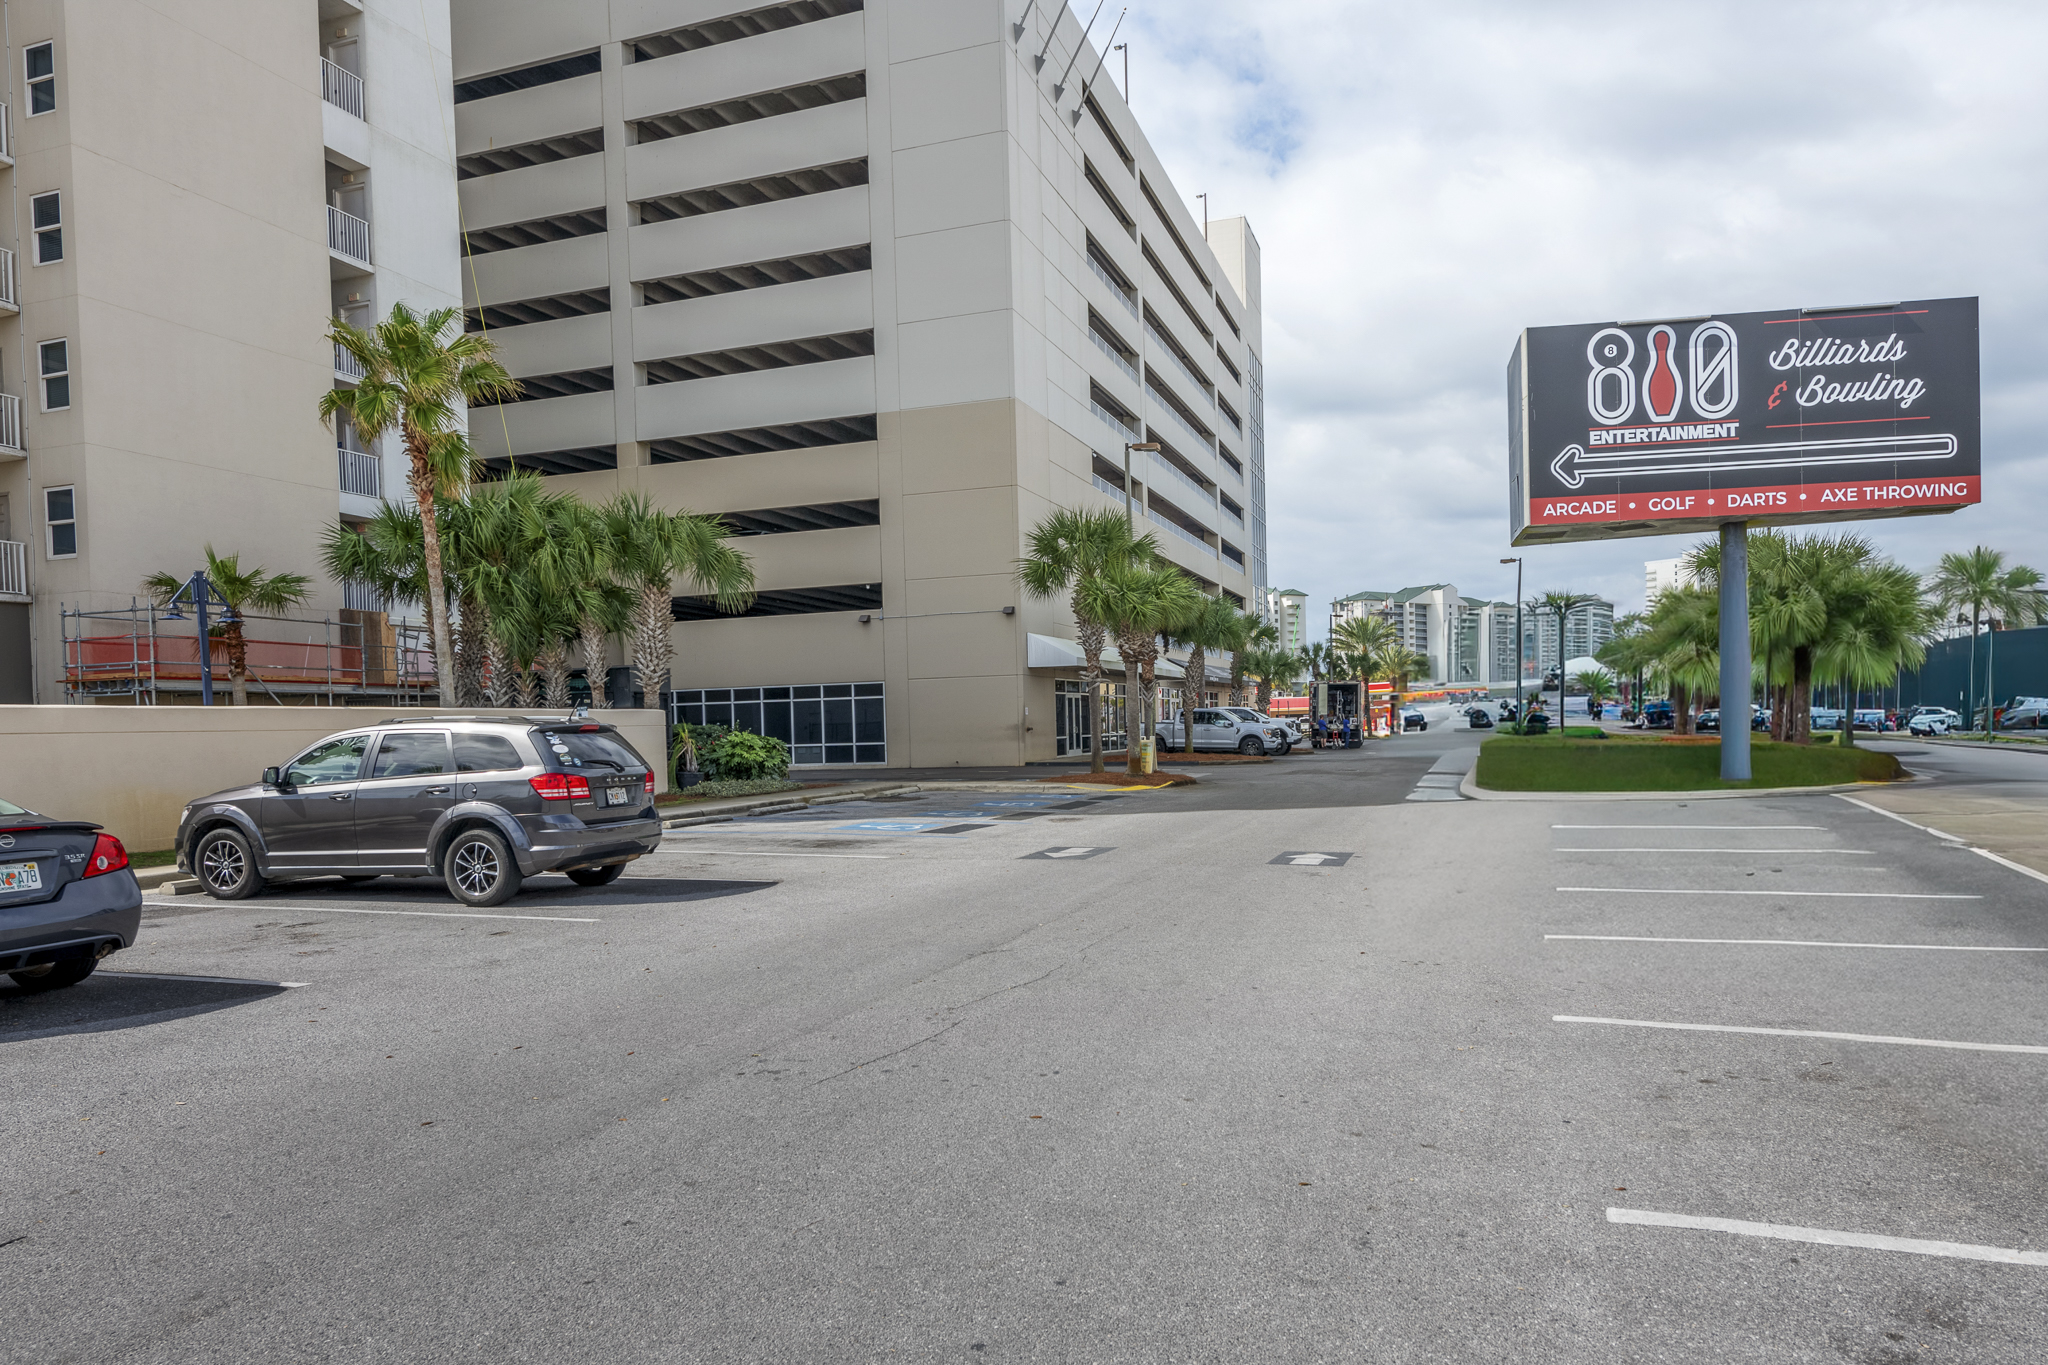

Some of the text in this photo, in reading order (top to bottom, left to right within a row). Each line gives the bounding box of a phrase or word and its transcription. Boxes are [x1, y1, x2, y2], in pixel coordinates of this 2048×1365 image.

[1768, 332, 1908, 371] Billiards
[1767, 372, 1927, 410] & Bowling
[1589, 422, 1740, 446] ENTERTAINMENT
[1648, 496, 1696, 512] GOLF
[1727, 491, 1788, 508] DARTS
[1820, 482, 1968, 504] AXE THROWING
[1543, 500, 1617, 517] ARCADE
